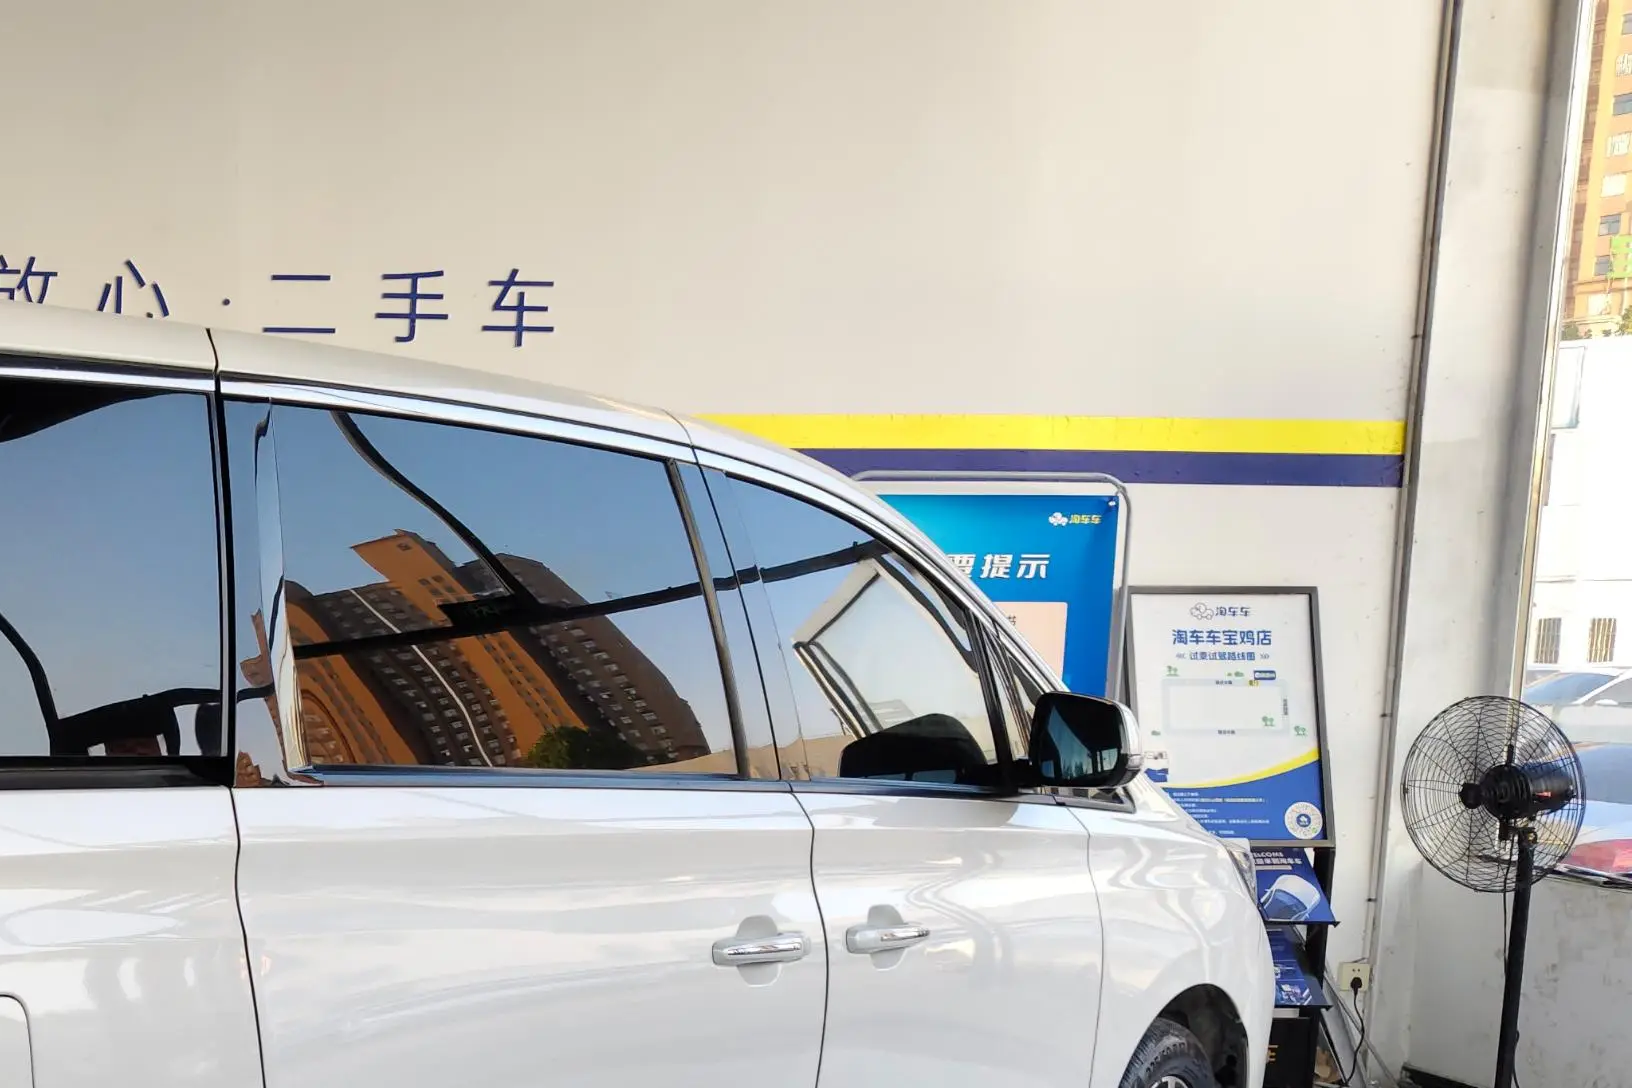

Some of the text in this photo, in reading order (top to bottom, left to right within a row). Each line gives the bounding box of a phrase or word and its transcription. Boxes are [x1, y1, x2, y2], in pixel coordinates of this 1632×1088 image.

[1215, 606, 1251, 617] 淘车车
[1172, 628, 1272, 645] 淘车车宝鸡店
